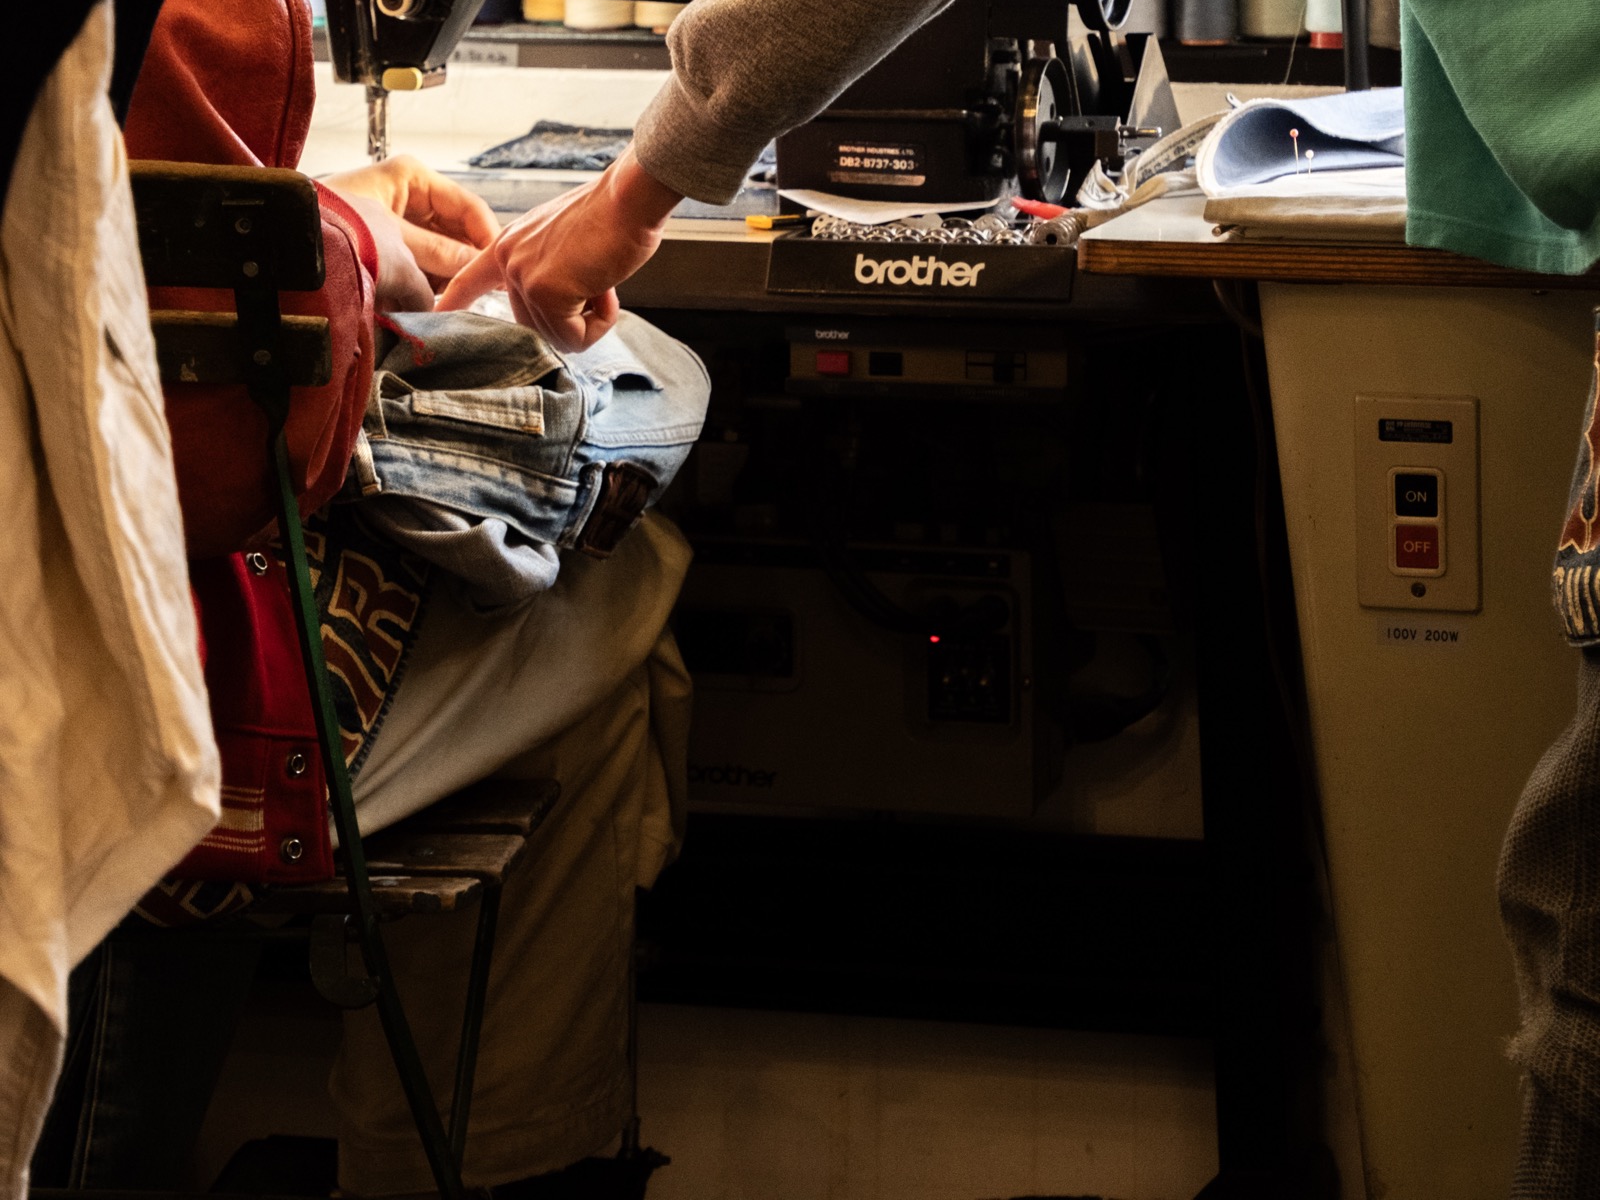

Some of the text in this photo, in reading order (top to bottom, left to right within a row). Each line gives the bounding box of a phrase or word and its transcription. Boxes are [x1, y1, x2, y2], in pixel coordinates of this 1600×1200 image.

[854, 253, 986, 287] brother
[815, 329, 849, 341] brother
[1405, 490, 1427, 503] ON
[1403, 540, 1431, 553] OFF
[1387, 628, 1459, 642] 100V 200W
